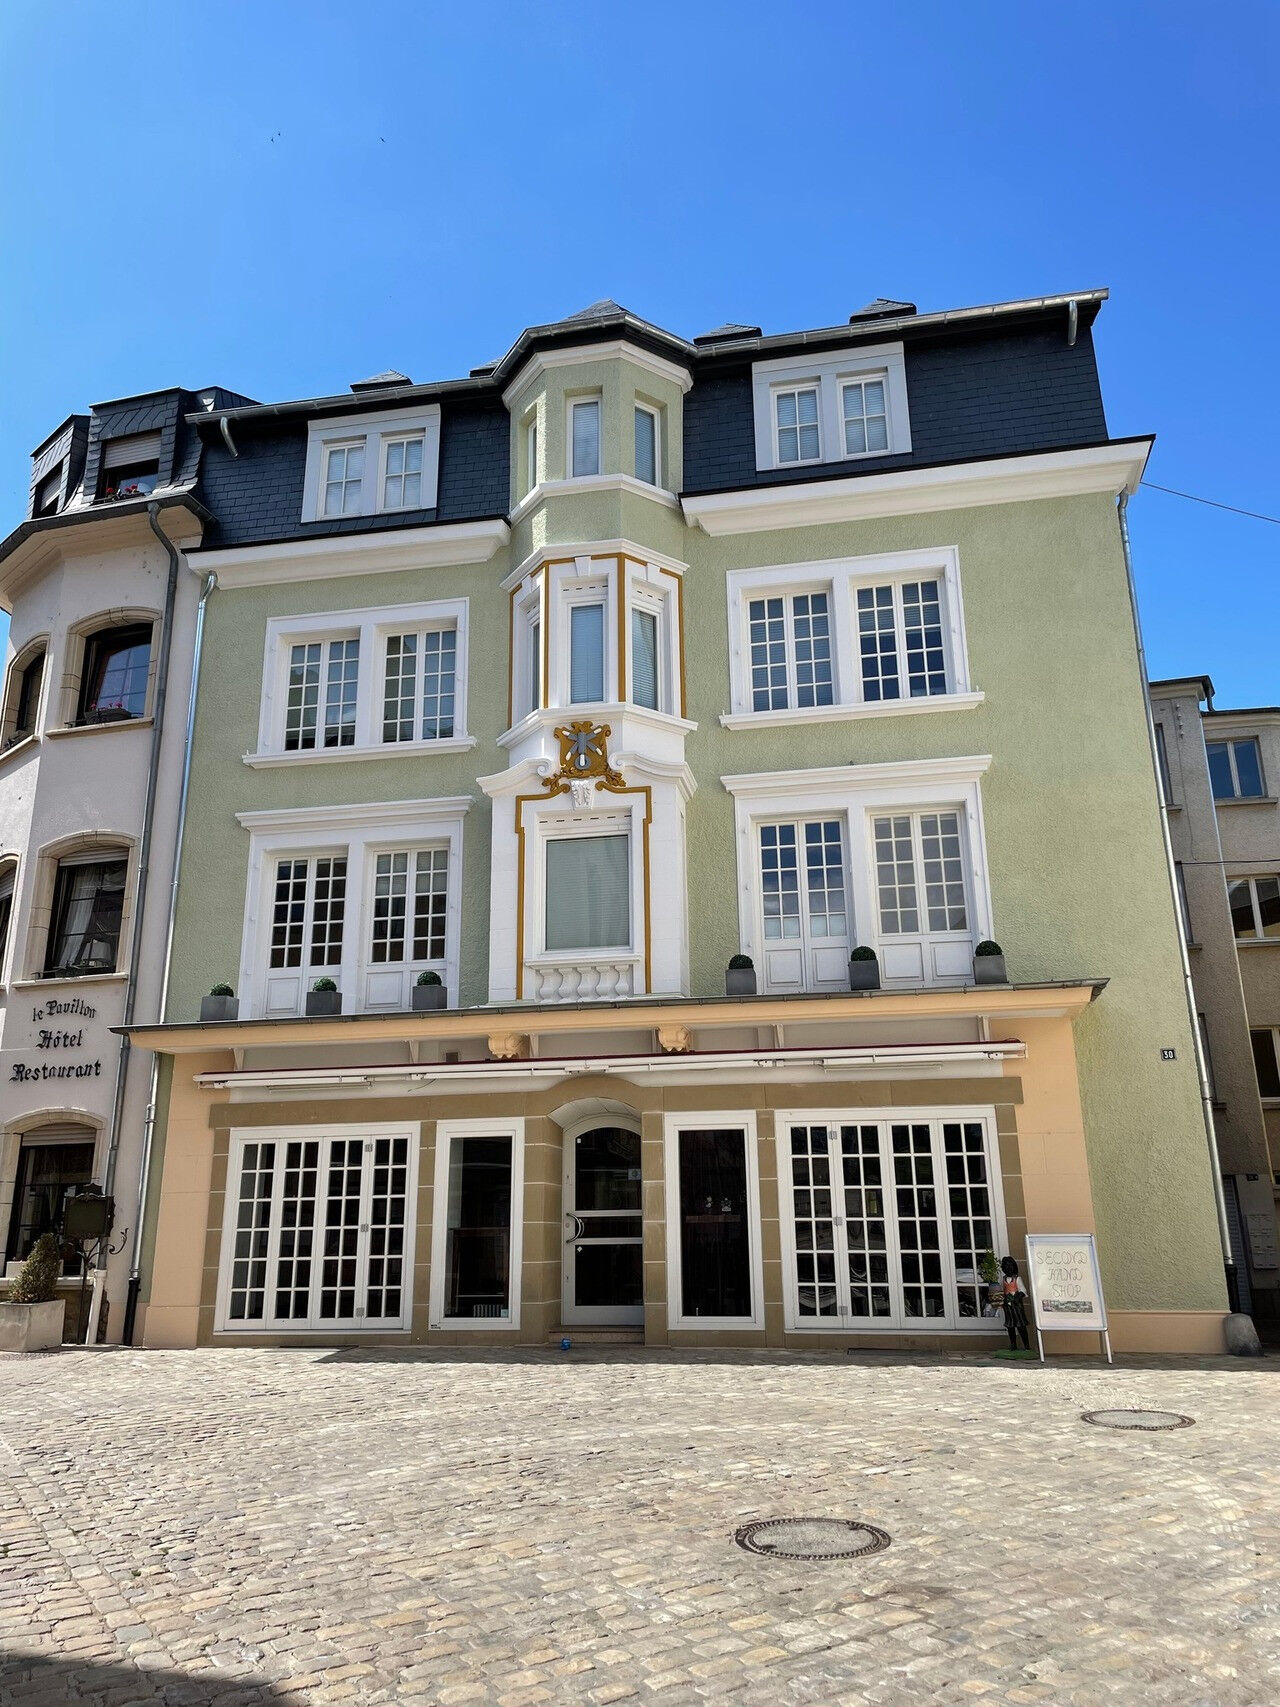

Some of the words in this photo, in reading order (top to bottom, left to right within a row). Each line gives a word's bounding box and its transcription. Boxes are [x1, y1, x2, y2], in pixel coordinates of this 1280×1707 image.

[46, 999, 97, 1018] Pavillon
[36, 1030, 83, 1048] Hôtel
[9, 1060, 101, 1081] Restaurant
[1036, 1251, 1088, 1265] SECOND
[1052, 1284, 1082, 1298] SHOP
